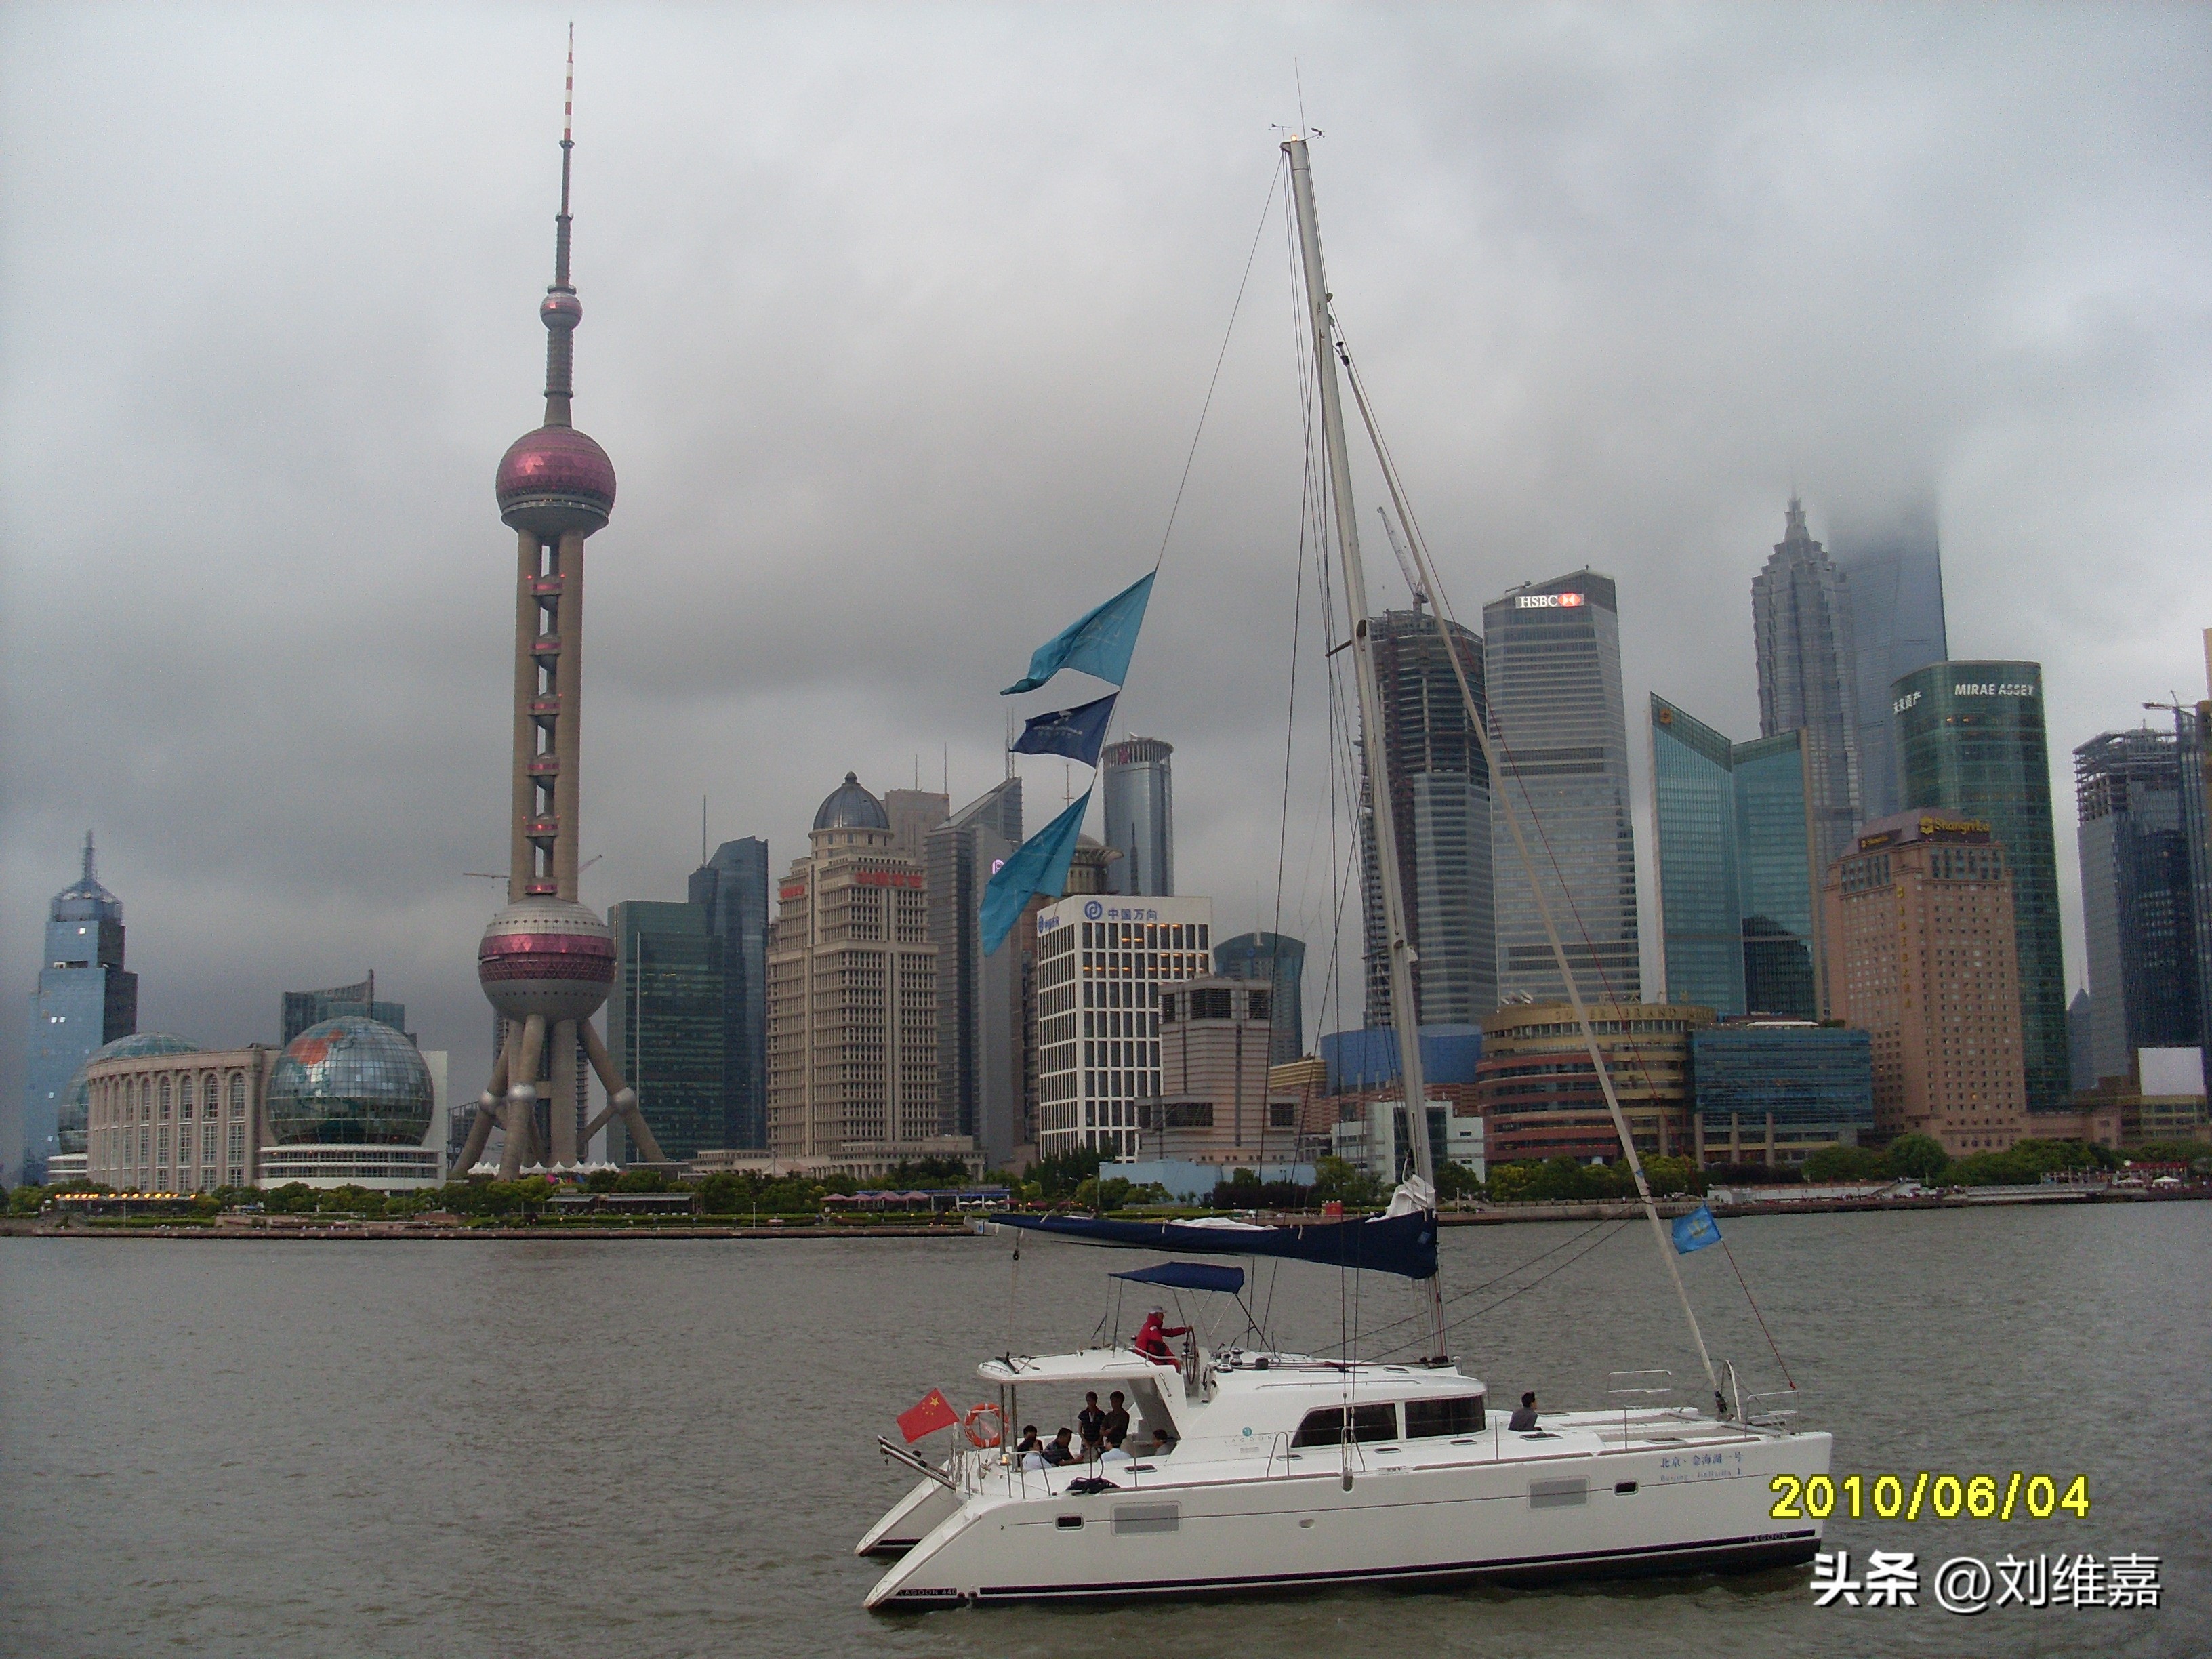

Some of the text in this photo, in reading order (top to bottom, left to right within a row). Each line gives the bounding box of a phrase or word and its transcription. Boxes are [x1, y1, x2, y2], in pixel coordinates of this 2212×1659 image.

[1520, 596, 1558, 608] HSBC
[1954, 684, 2034, 696] MIRAE ASSET
[1108, 908, 1158, 921] 中国万向
[1555, 1008, 1607, 1020] SUER
[1224, 1435, 1272, 1444] LAGOON
